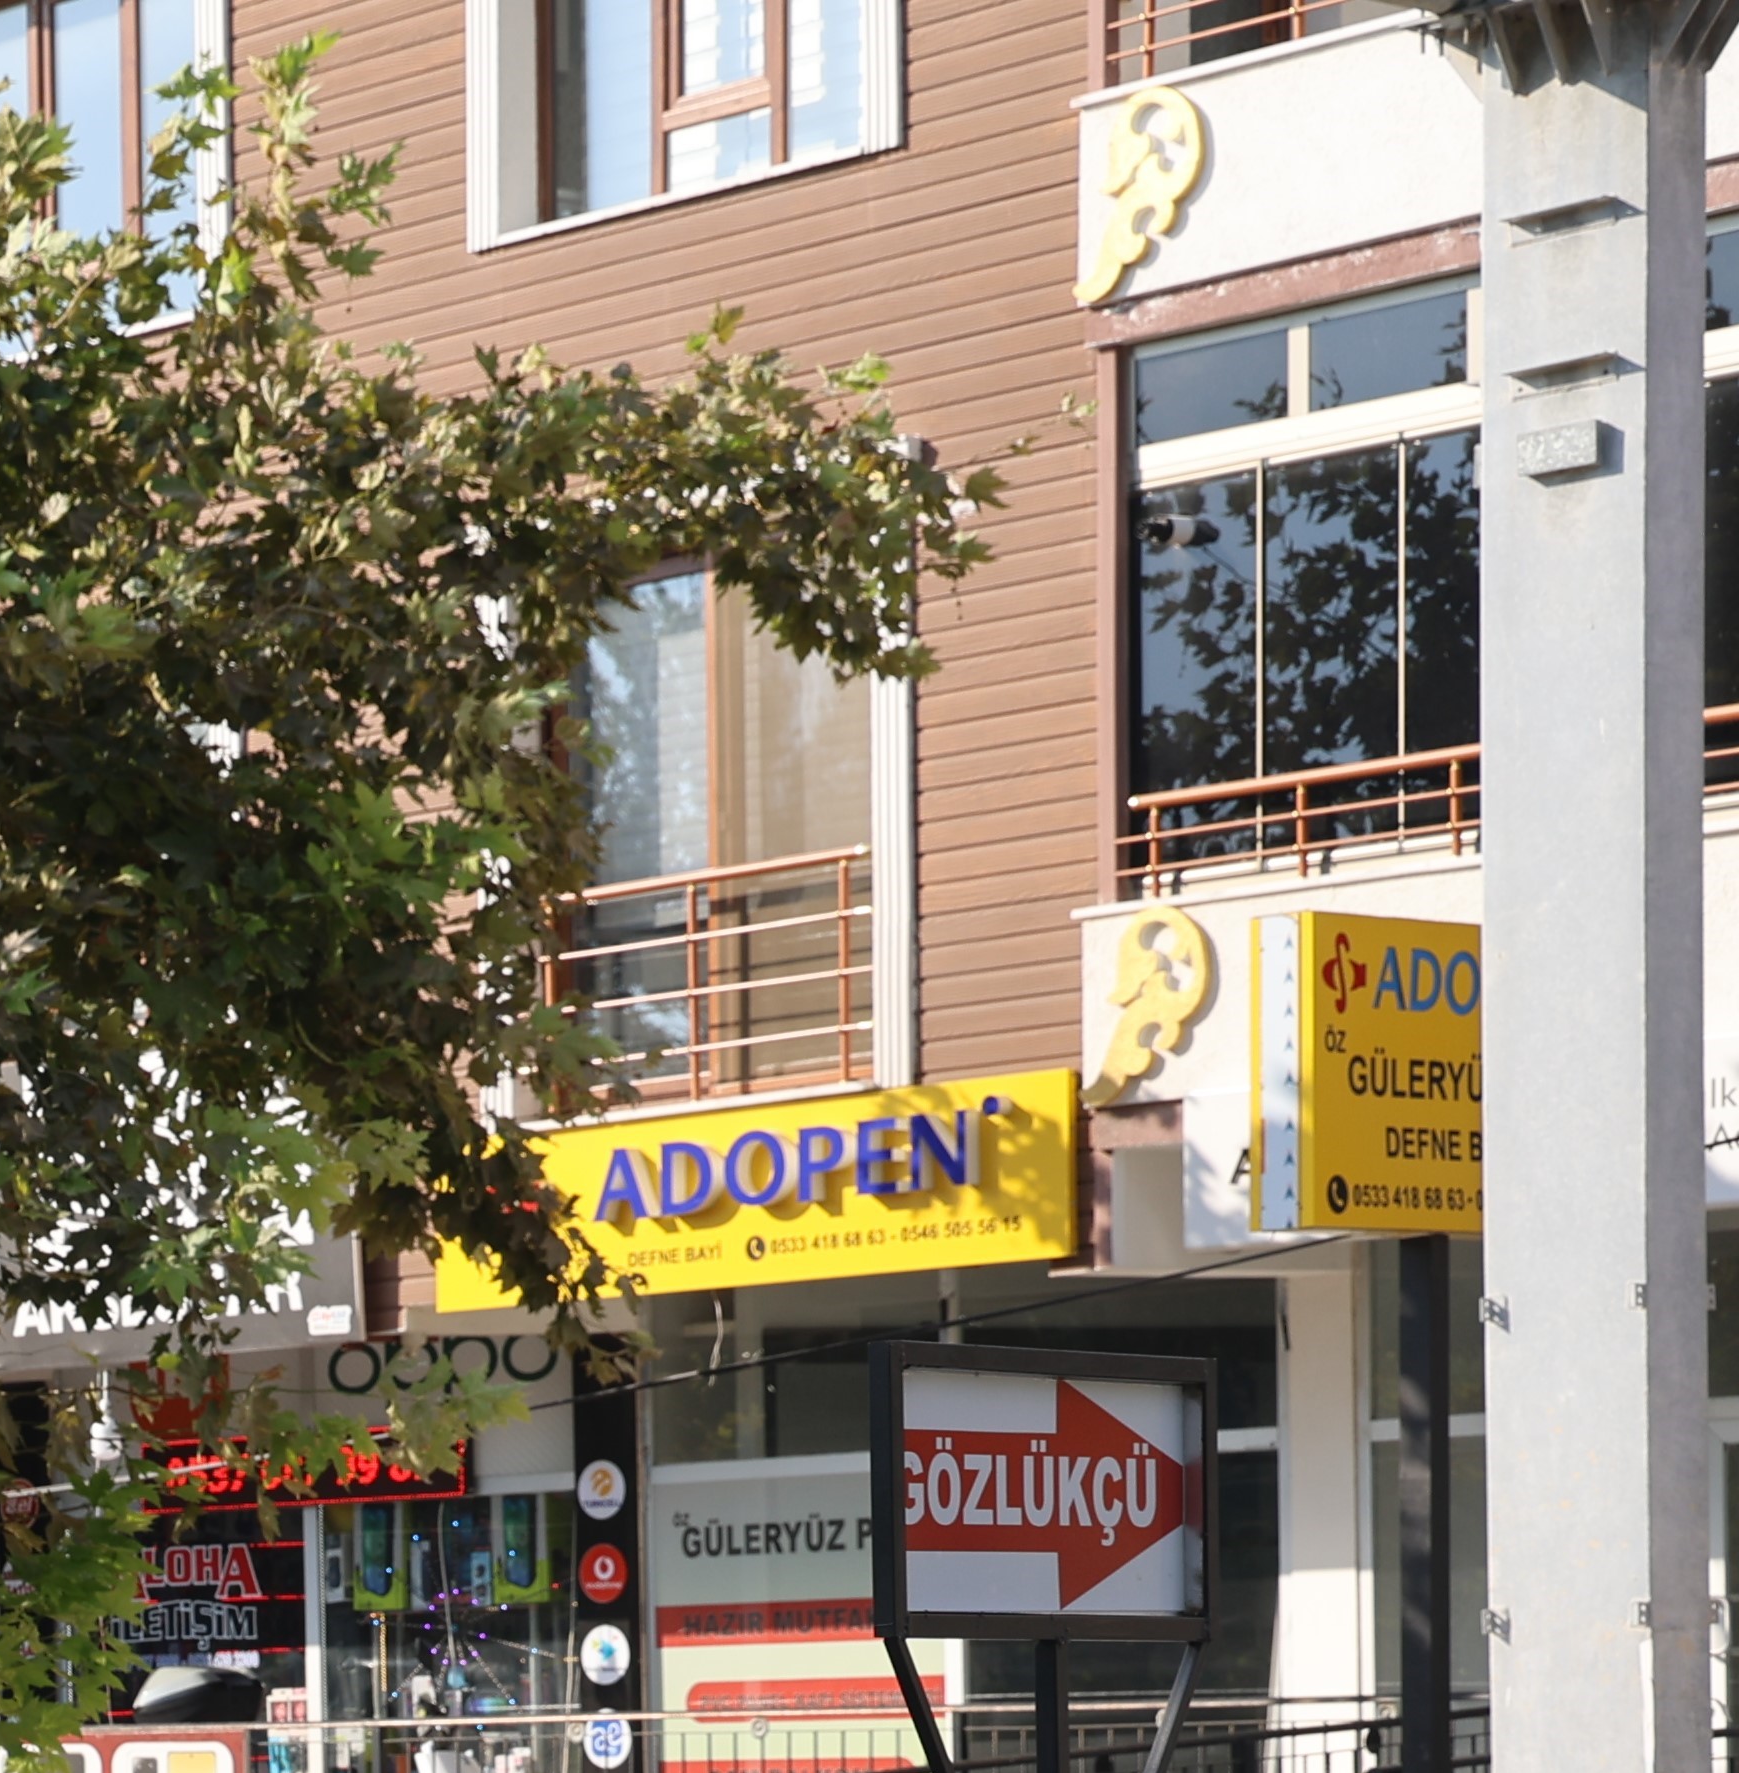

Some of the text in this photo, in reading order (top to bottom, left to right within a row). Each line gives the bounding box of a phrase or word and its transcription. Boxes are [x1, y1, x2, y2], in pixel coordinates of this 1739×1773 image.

[1325, 1026, 1346, 1053] ÖZ
[1348, 1048, 1482, 1102] GÜLERYÜ
[1386, 1127, 1462, 1160] DEFNE
[595, 1111, 971, 1221] ADOPEN
[1353, 1184, 1389, 1208] 0533
[1393, 1186, 1420, 1209] 418
[1425, 1187, 1443, 1210] 68
[1447, 1188, 1465, 1211] 63
[628, 1242, 722, 1268] DEFNE BAYİ
[770, 1236, 806, 1256] 0533
[812, 1233, 838, 1250] 418
[844, 1231, 862, 1247] 68
[867, 1228, 885, 1245] 63
[901, 1224, 939, 1242] 0546
[904, 1436, 1157, 1547] GÖZLÜKÇÜ
[682, 1513, 845, 1558] GÜLERYÜZ
[683, 1612, 764, 1636] HAZIR
